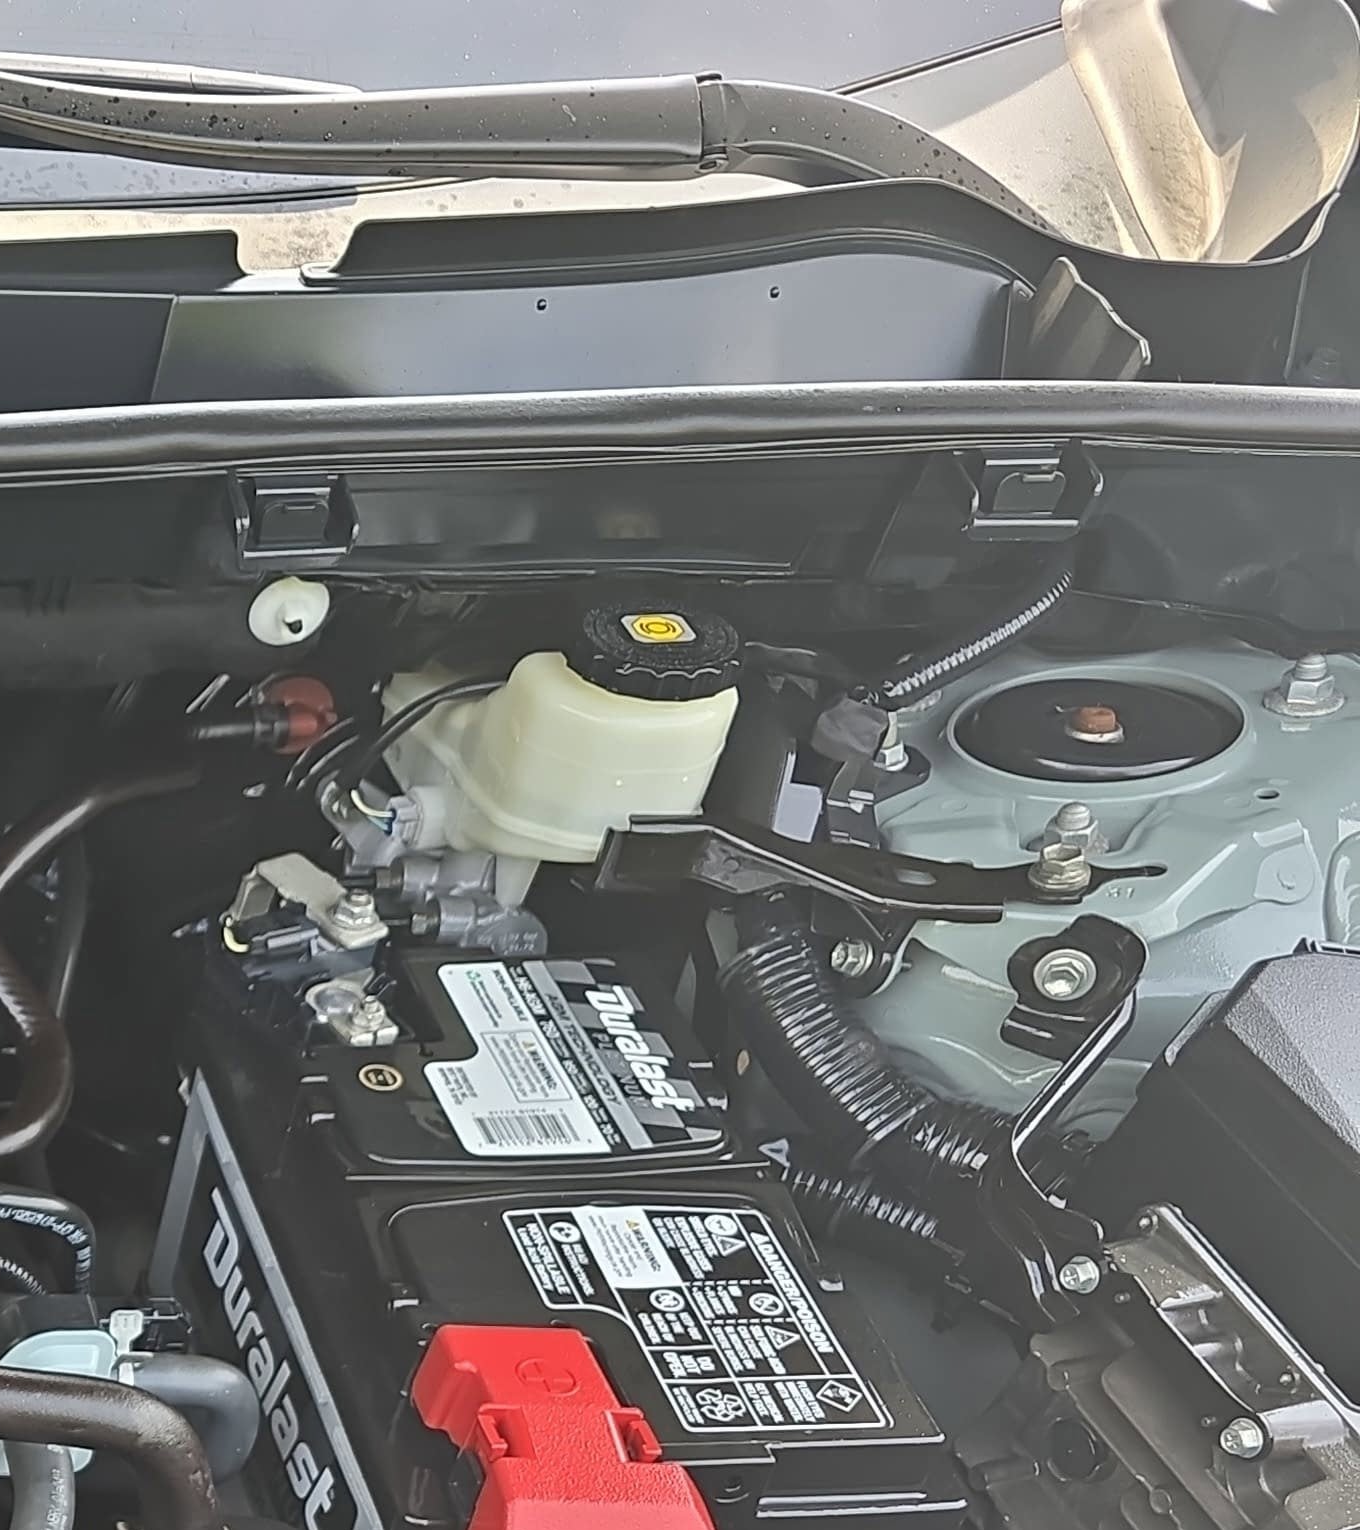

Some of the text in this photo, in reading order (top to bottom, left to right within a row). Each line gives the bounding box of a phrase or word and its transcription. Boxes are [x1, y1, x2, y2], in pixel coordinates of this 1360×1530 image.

[544, 993, 622, 1106] AGM TECHNOLOGY
[584, 985, 697, 1112] Duralast
[525, 1222, 571, 1295] NON-SPILLABLE
[756, 1241, 835, 1353] DANGER/POISON
[679, 1354, 702, 1375] NOT
[695, 1356, 716, 1370] DO
